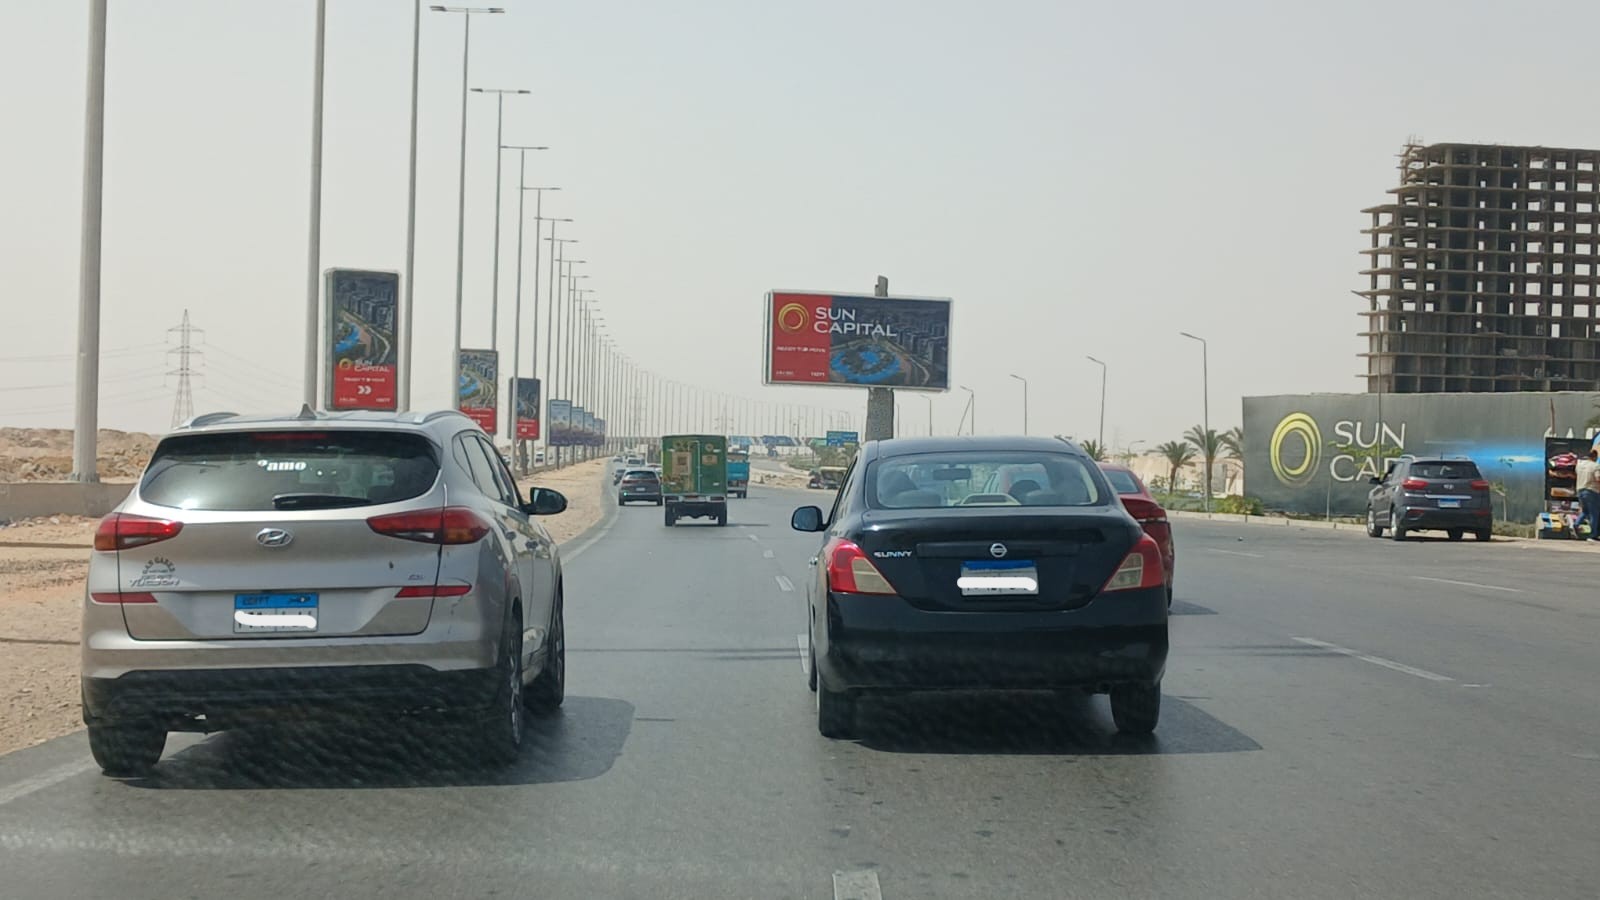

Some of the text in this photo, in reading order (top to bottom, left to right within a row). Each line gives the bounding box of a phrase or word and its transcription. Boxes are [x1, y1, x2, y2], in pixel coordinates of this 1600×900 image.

[815, 306, 856, 321] SUN
[813, 321, 898, 337] CAPITAL
[1334, 420, 1406, 450] SUN
[873, 550, 913, 558] SUNNY
